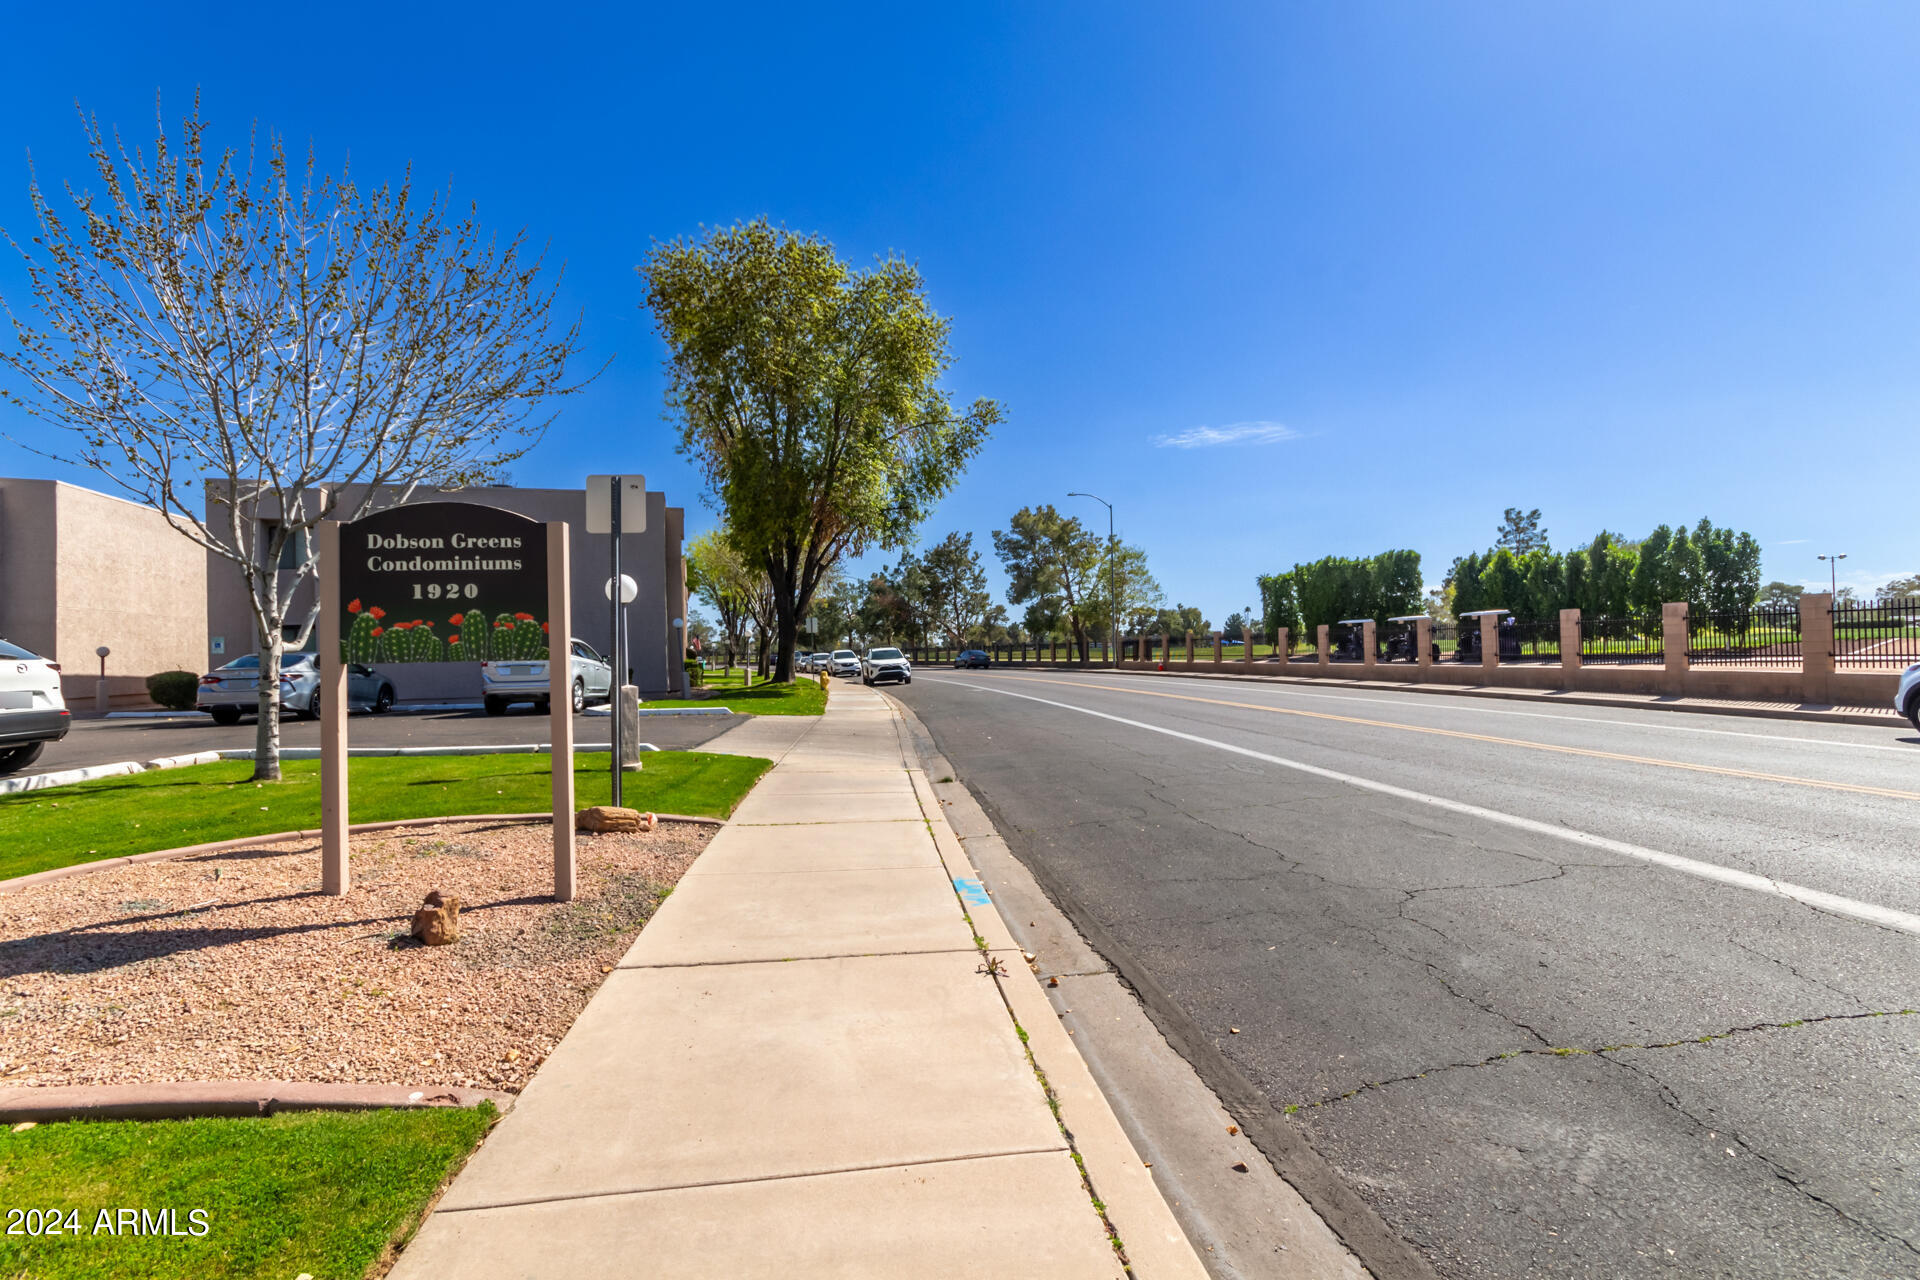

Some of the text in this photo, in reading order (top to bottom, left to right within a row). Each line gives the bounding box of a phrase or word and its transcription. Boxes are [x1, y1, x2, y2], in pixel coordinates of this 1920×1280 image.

[367, 533, 522, 549] Dobson Greens
[367, 555, 522, 572] Condominiums
[412, 583, 479, 600] 1920
